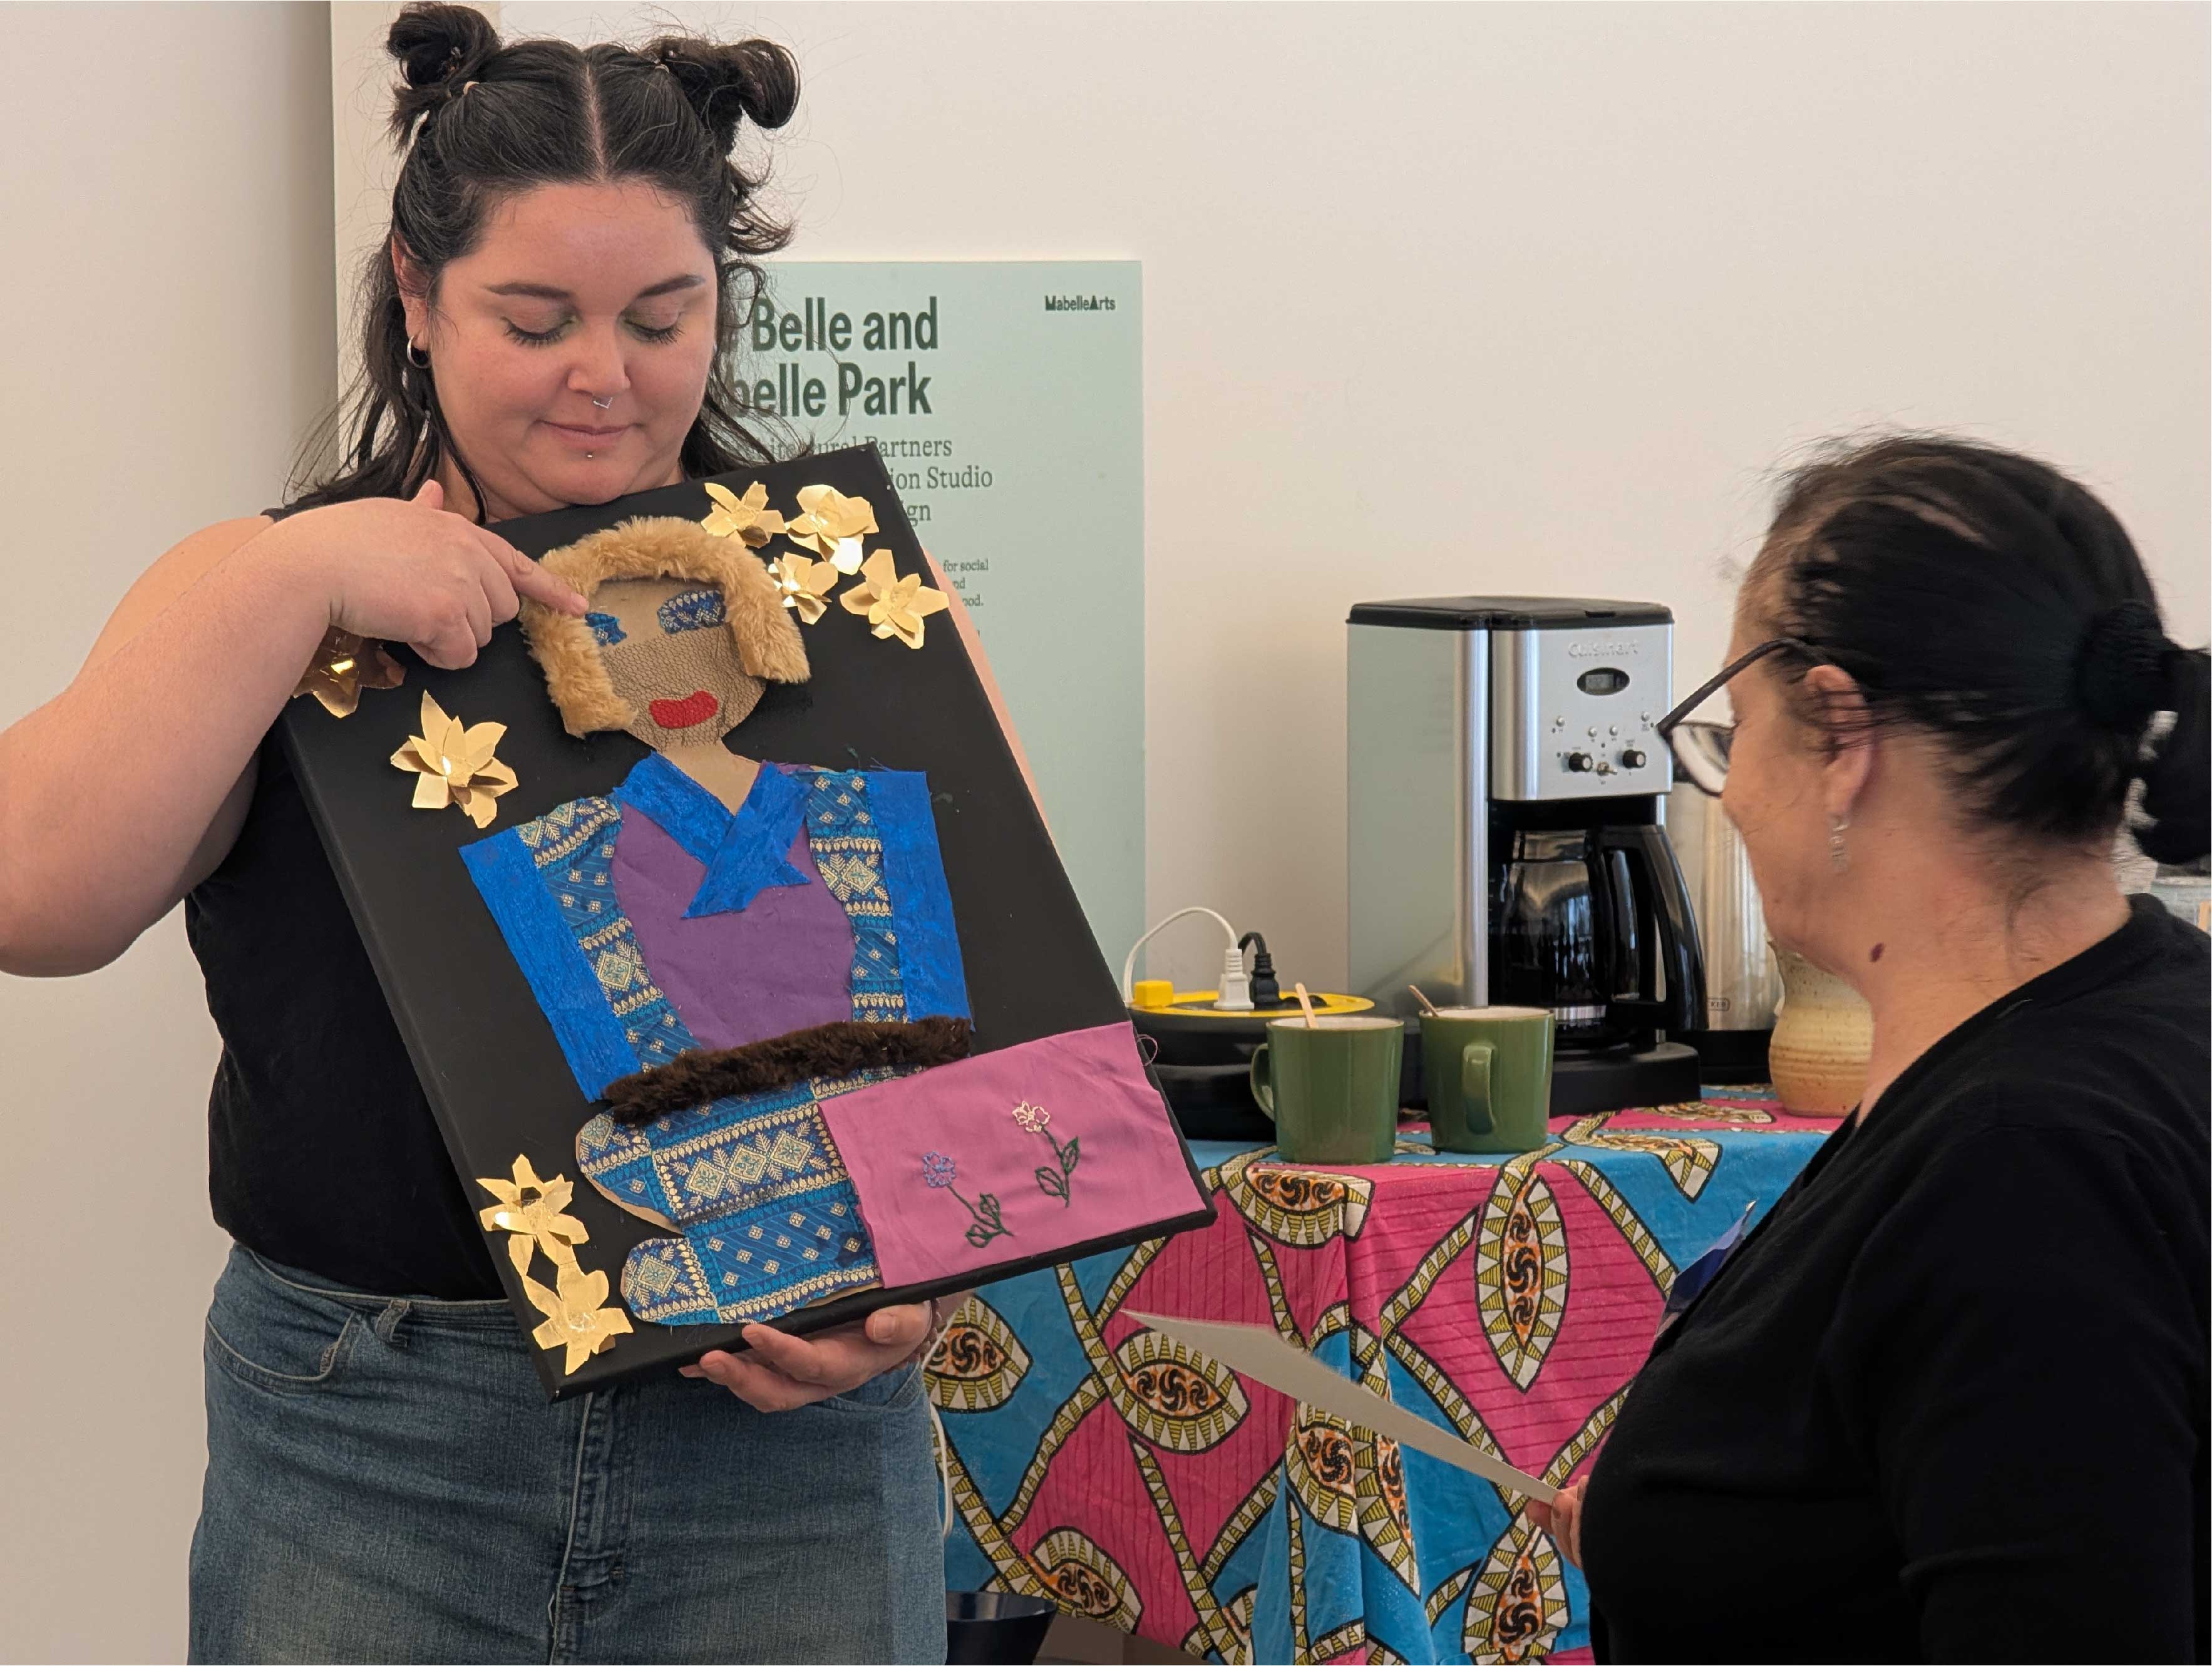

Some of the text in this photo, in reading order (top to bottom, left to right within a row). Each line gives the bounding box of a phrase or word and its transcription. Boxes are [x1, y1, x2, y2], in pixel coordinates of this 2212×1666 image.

[1044, 295, 1116, 311] MabelleArts
[753, 297, 852, 352] Belle
[863, 296, 938, 351] and
[838, 361, 932, 416] Park
[927, 465, 993, 489] Studio
[903, 501, 932, 527] gn
[943, 558, 989, 572] for social
